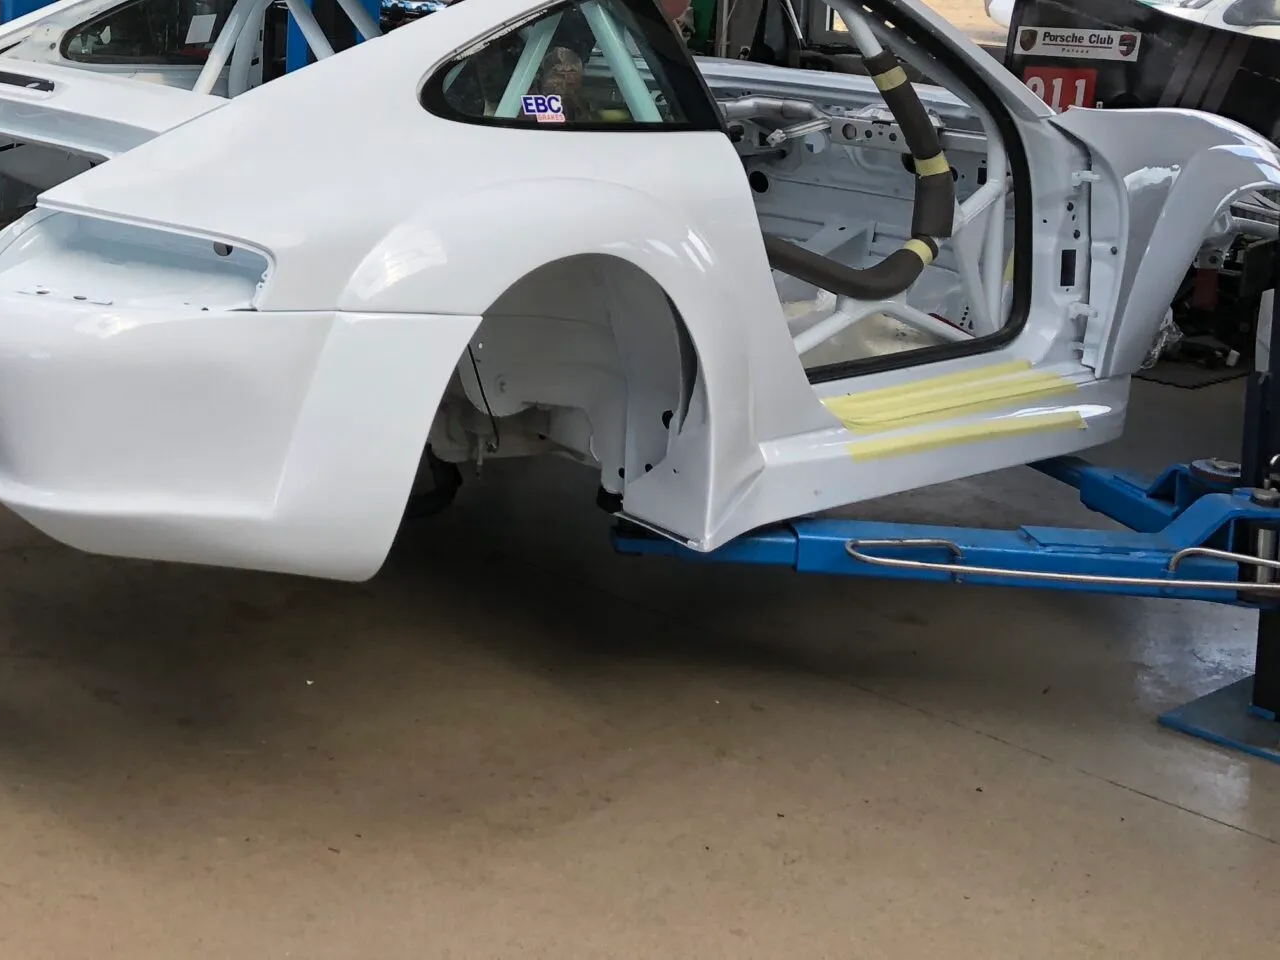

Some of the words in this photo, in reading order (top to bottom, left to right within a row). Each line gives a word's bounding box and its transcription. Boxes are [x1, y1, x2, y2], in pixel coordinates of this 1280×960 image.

[1042, 31, 1084, 44] Porsche
[1088, 33, 1114, 46] Club
[522, 96, 562, 113] EBC
